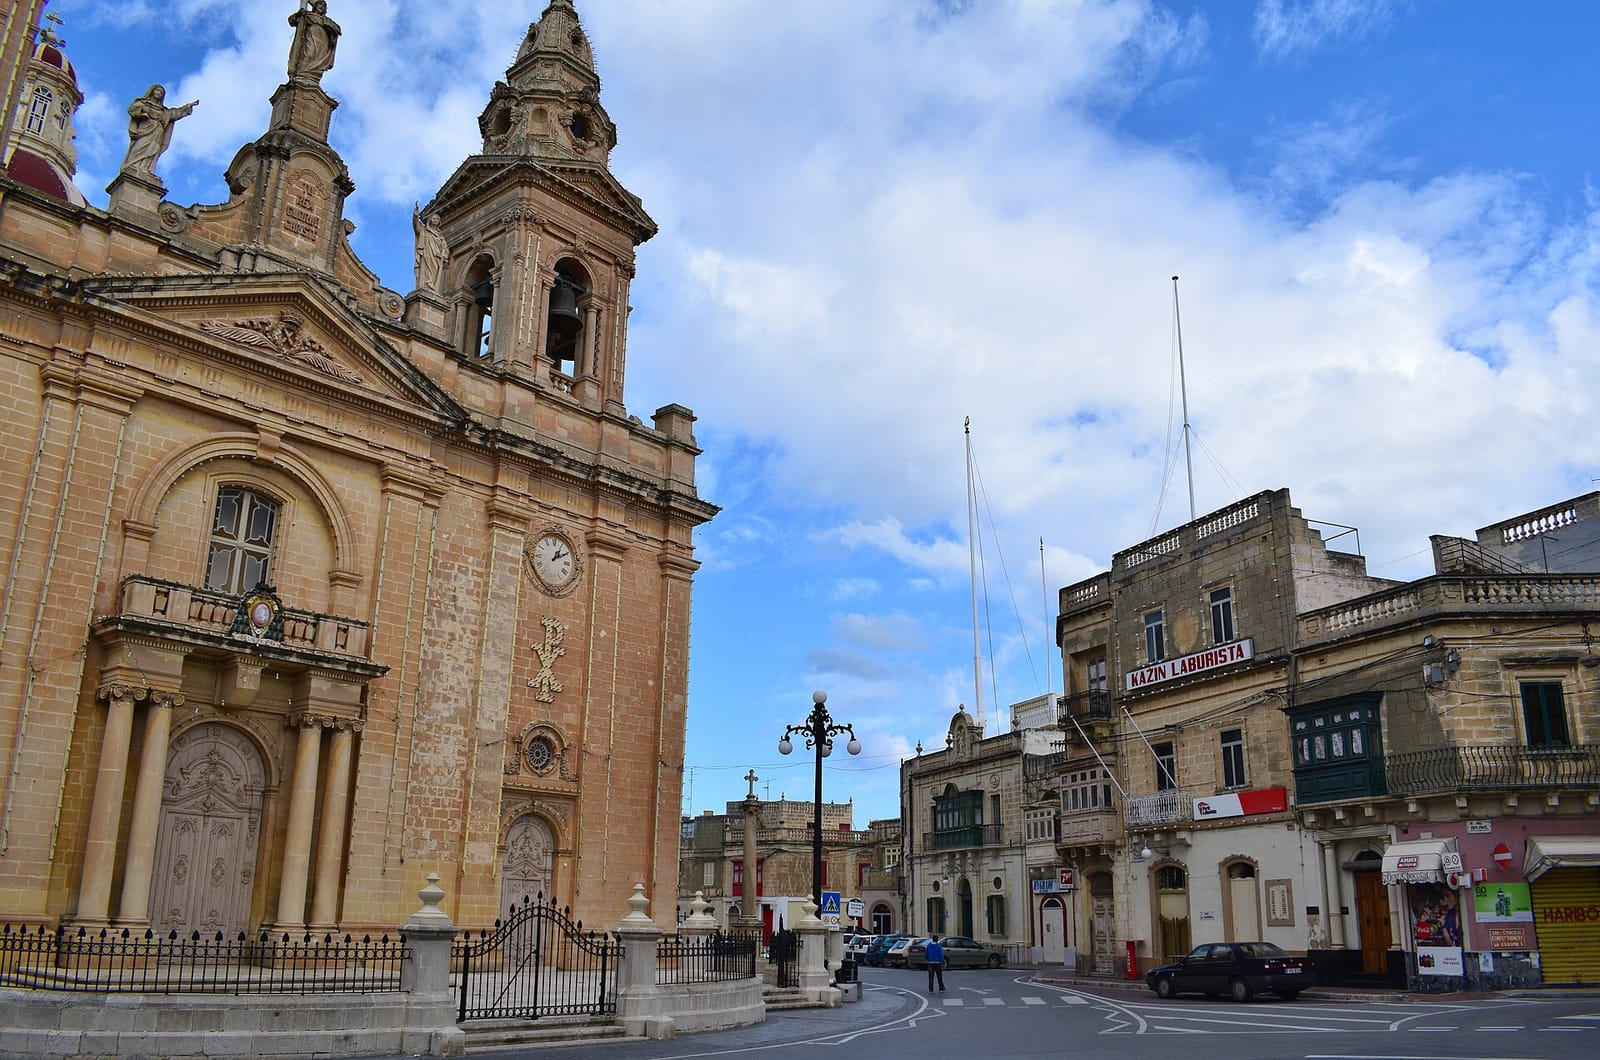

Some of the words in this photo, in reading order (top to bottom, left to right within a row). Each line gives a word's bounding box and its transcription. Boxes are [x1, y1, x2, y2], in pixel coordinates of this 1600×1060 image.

[1131, 666, 1167, 687] KAZIN
[1171, 643, 1245, 677] LABURISTA
[1543, 906, 1599, 923] HARIBO
